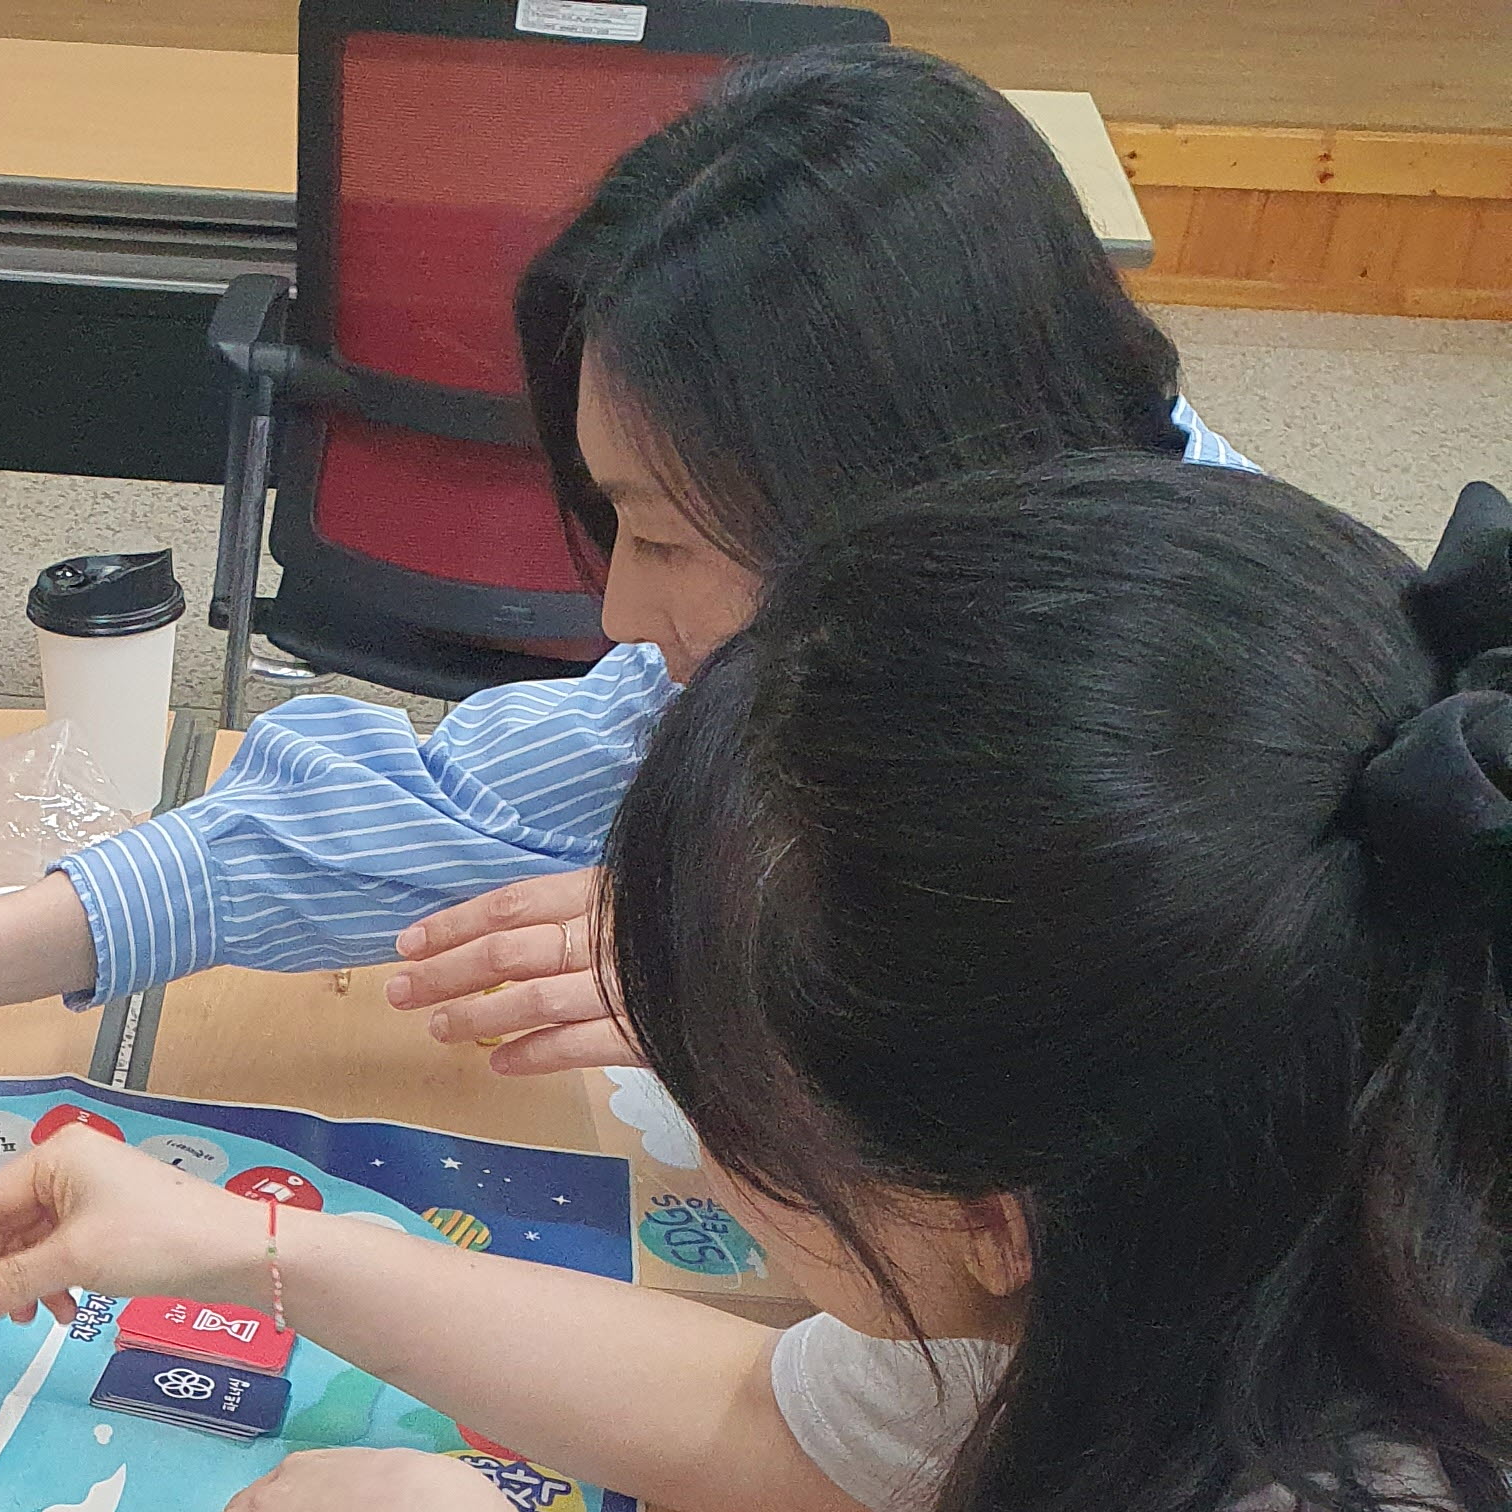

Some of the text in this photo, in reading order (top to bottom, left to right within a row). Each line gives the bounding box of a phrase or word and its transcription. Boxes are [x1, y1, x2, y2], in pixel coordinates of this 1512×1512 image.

[644, 1194, 726, 1266] SDGs
[164, 1304, 187, 1324] 시간
[222, 1378, 251, 1412] 파트너십
